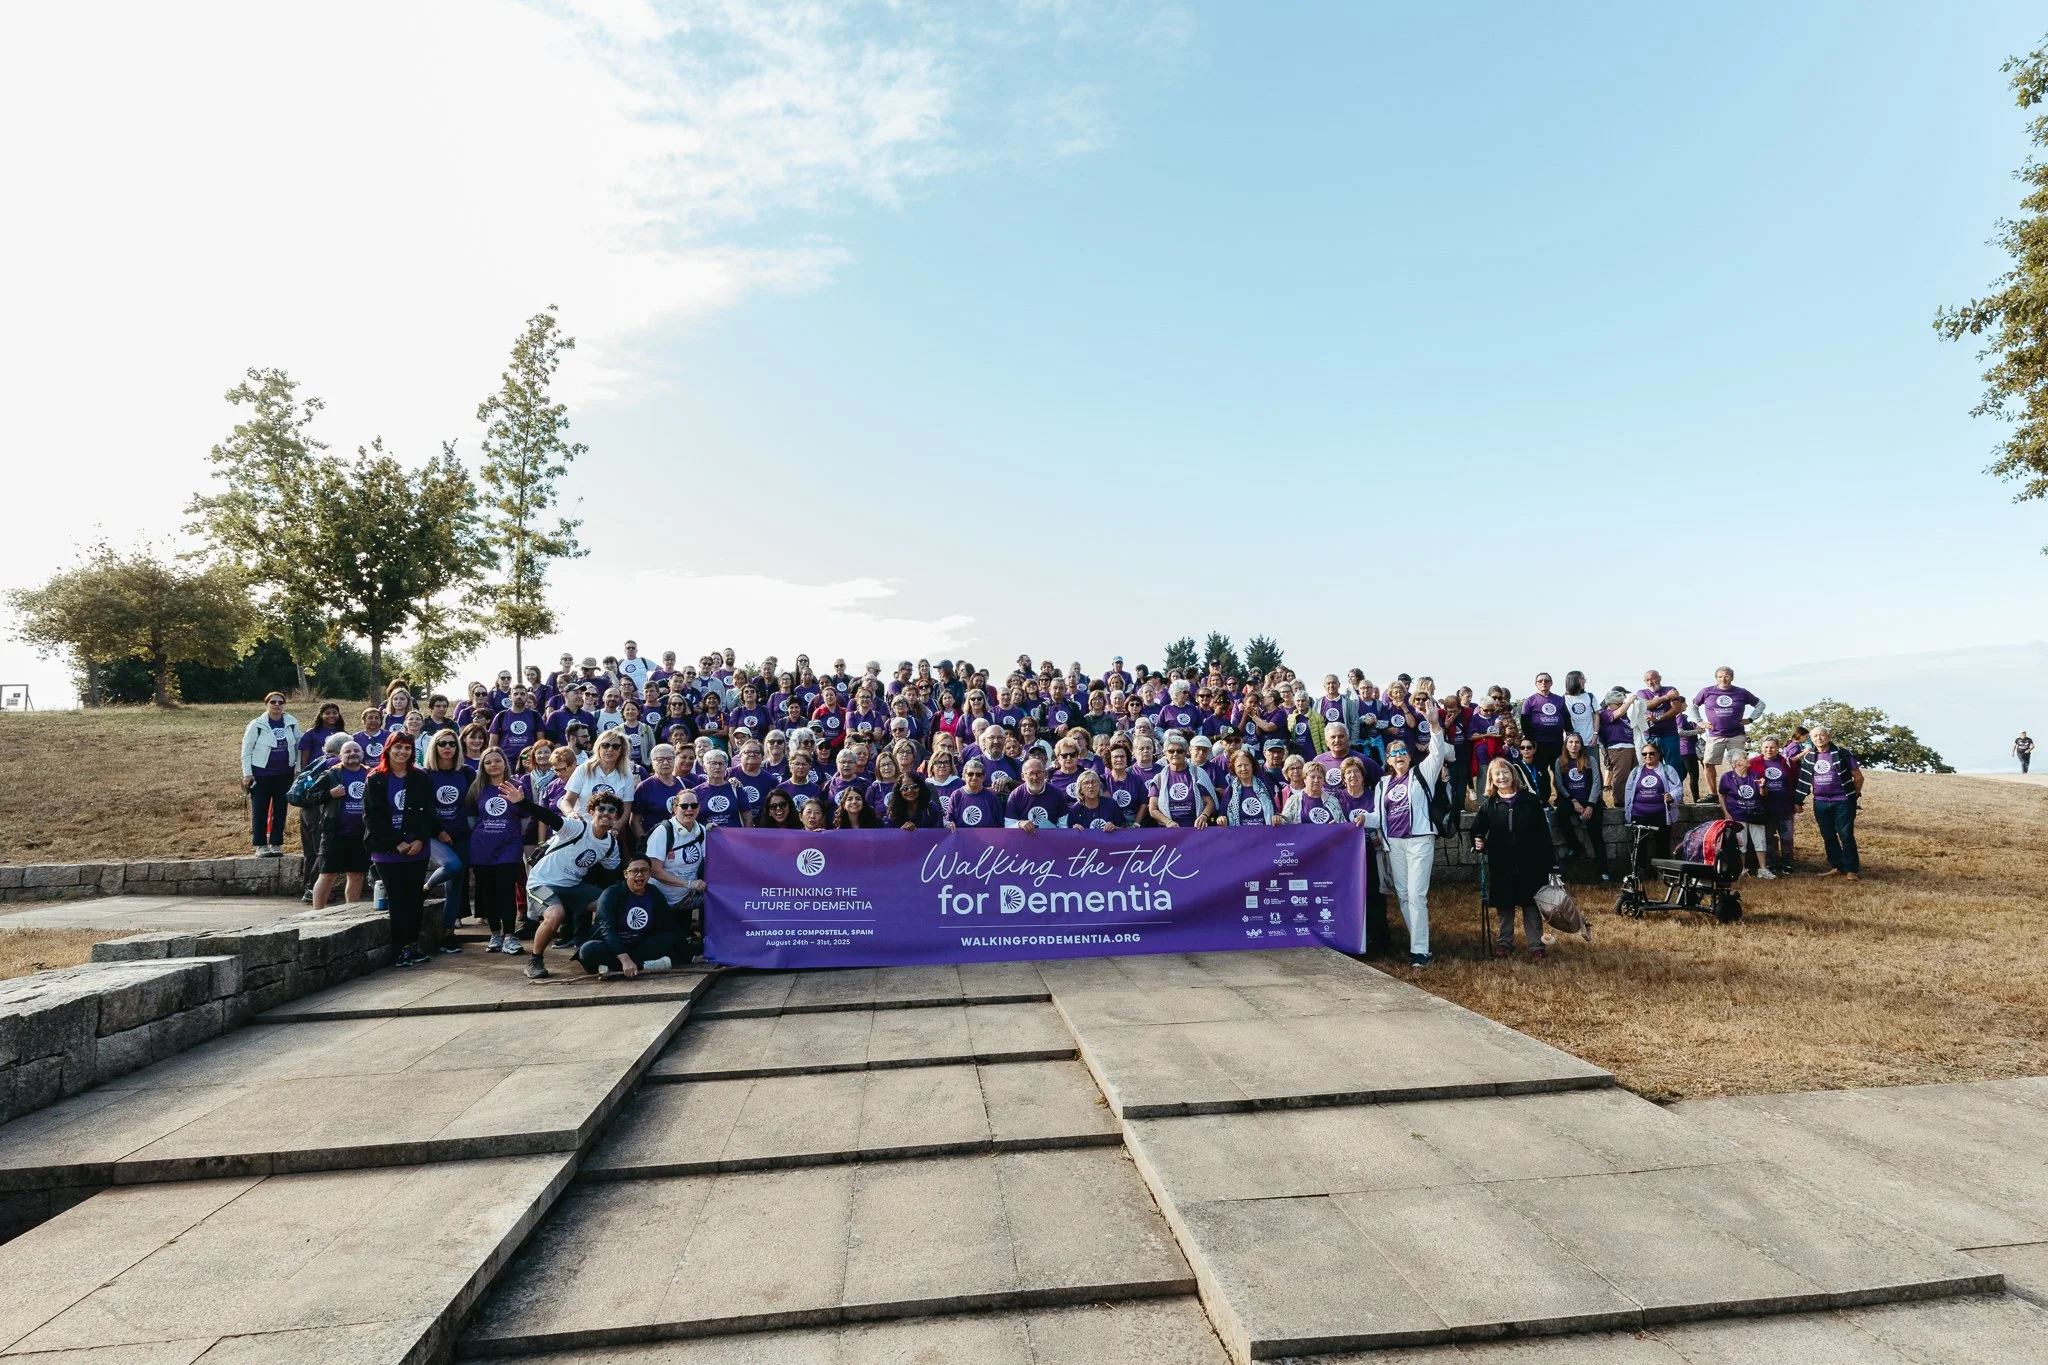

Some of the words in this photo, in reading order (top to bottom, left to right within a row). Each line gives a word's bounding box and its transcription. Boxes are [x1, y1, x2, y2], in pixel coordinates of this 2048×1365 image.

[921, 843, 1062, 888] Walking
[1068, 847, 1114, 878] the
[1108, 844, 1200, 886] Talk
[761, 887, 833, 897] RETHINKING
[835, 887, 858, 897] THE
[937, 884, 990, 915] for
[999, 882, 1173, 915] Dementia
[744, 901, 791, 911] FUTURE
[793, 901, 810, 911] OF
[812, 900, 873, 911] DEMENTIA
[797, 929, 850, 937] COMPOSTELA,
[766, 939, 791, 947] August
[816, 939, 832, 947] 31st,
[833, 938, 851, 946] 2025
[960, 933, 1141, 947] WALKINGFORDEMENTIA.ORG
